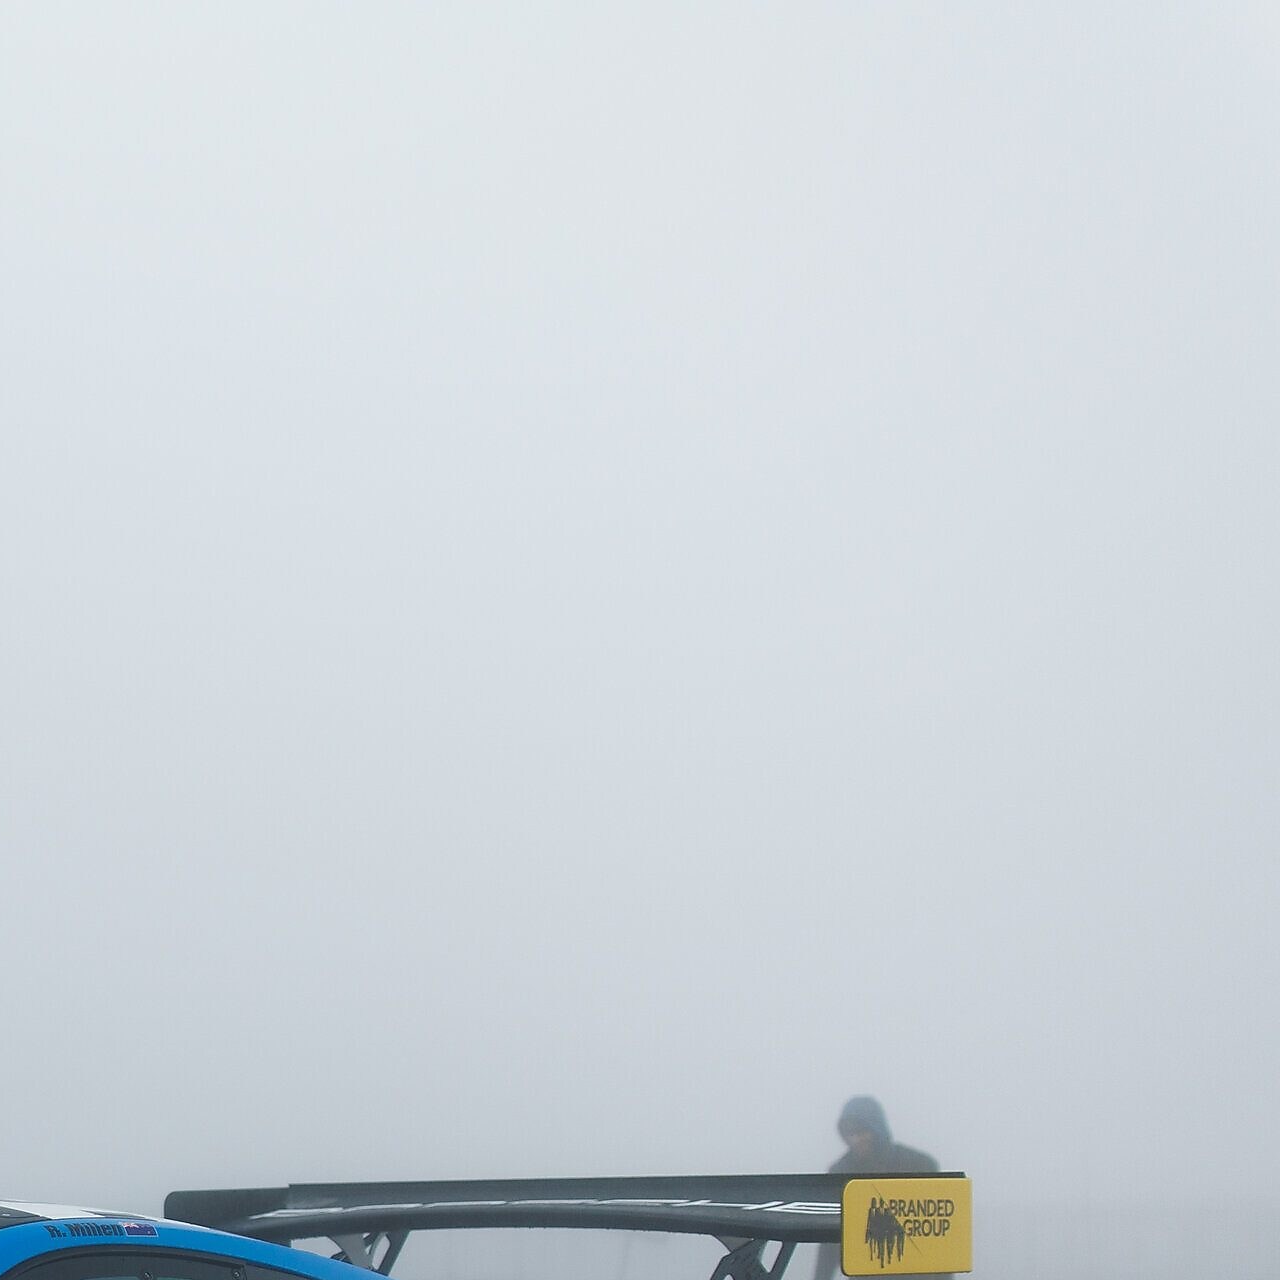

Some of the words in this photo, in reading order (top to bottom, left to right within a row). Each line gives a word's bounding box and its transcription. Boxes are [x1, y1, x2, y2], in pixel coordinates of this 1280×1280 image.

[890, 1199, 954, 1218] BRANDED
[64, 1222, 125, 1238] Millen
[903, 1219, 951, 1237] GROUP
